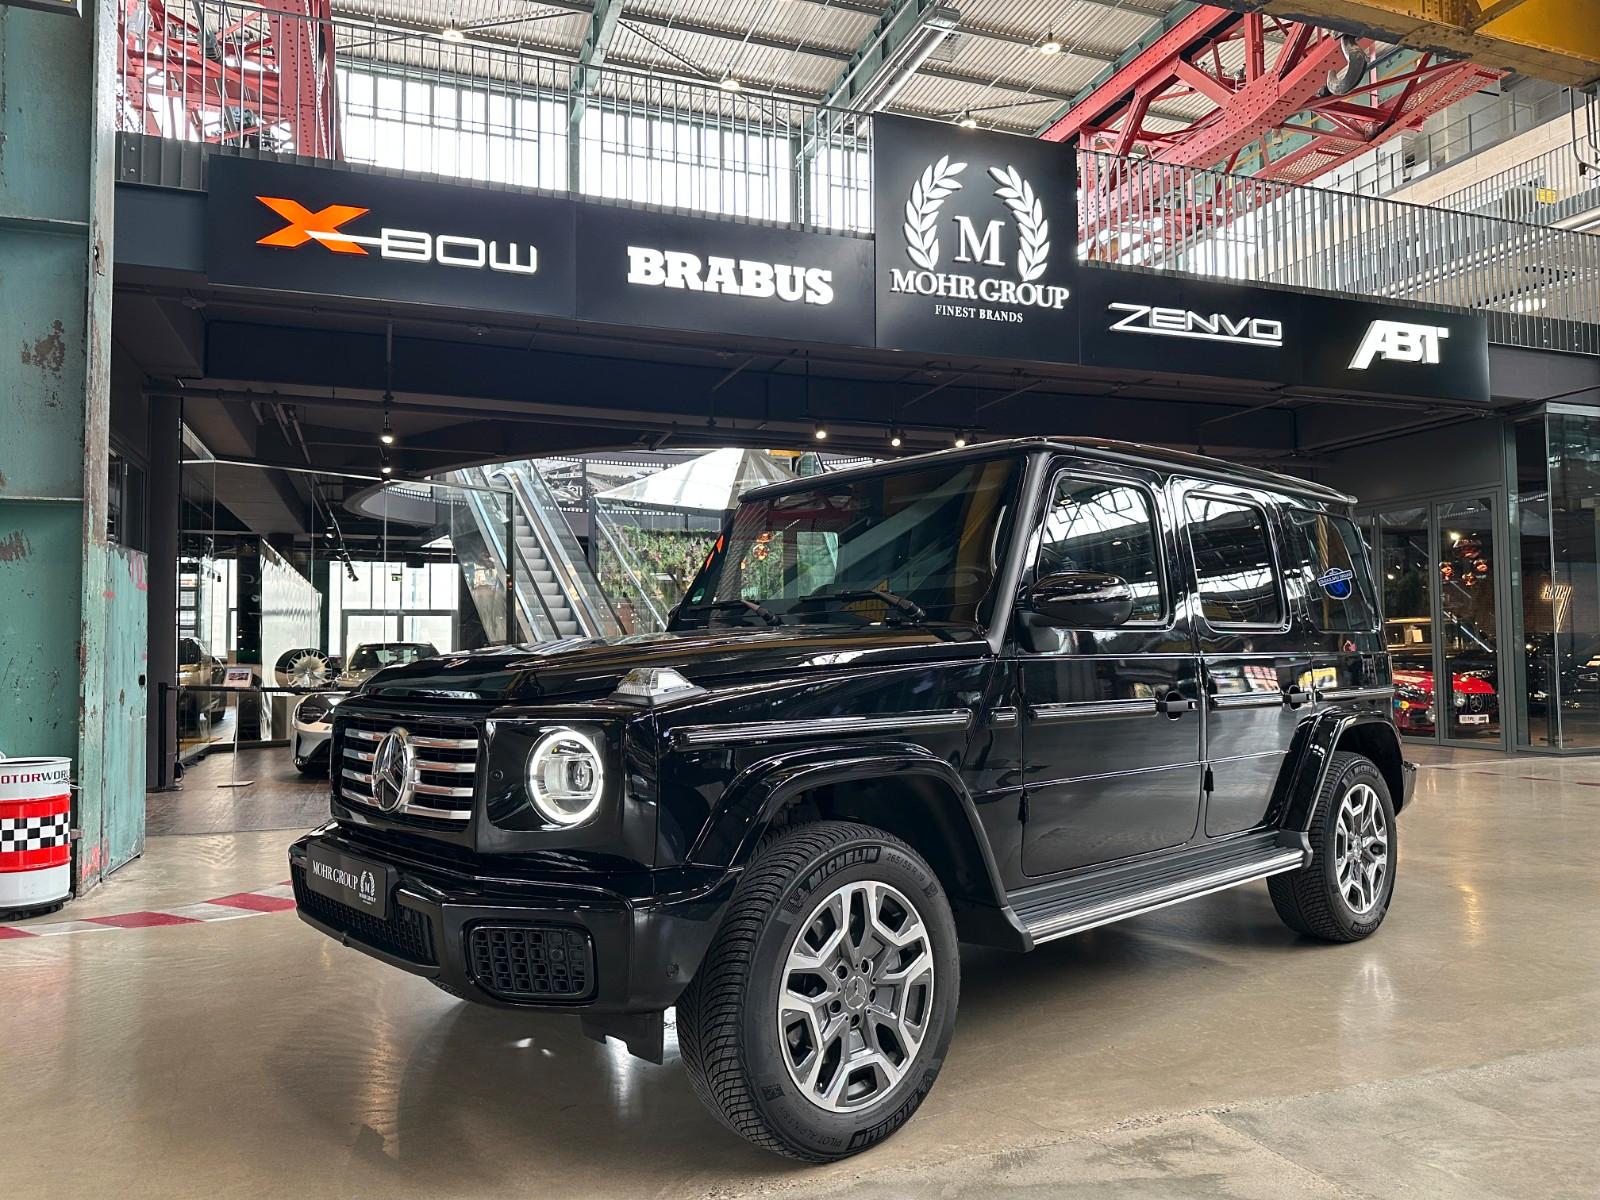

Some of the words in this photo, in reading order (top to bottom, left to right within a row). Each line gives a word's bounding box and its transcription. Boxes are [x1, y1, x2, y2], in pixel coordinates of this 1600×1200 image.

[954, 215, 1006, 267] M
[627, 245, 834, 306] BRABUS
[890, 268, 978, 300] MOHR
[979, 277, 1070, 310] GROUP
[934, 304, 976, 319] FINEST
[979, 308, 1024, 323] BRANDS
[1108, 302, 1284, 348] ZENVO
[1347, 319, 1450, 371] ABT
[312, 859, 333, 881] MOHR
[333, 868, 359, 890] GROUP
[808, 847, 880, 889] MICHELIN
